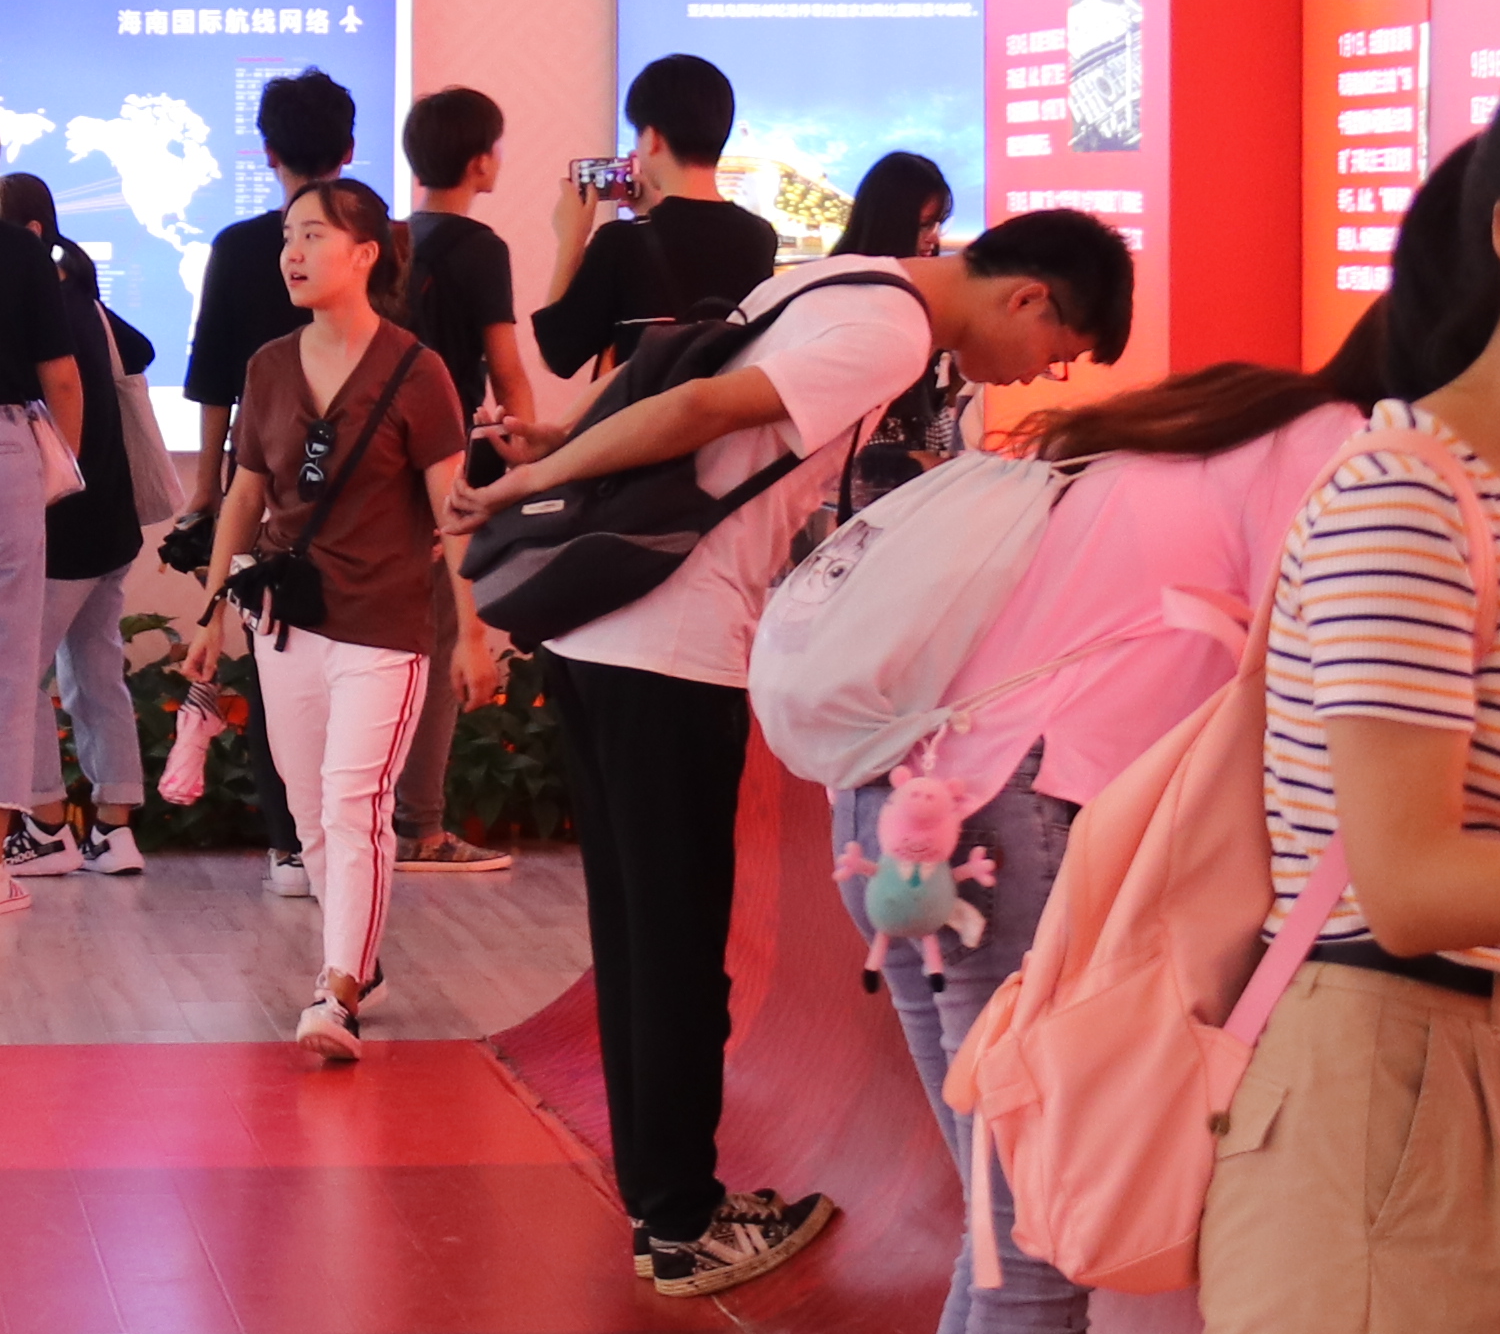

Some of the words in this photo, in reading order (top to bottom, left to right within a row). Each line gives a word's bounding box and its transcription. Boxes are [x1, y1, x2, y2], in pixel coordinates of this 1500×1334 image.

[117, 8, 330, 35] 海南国际航线网络
